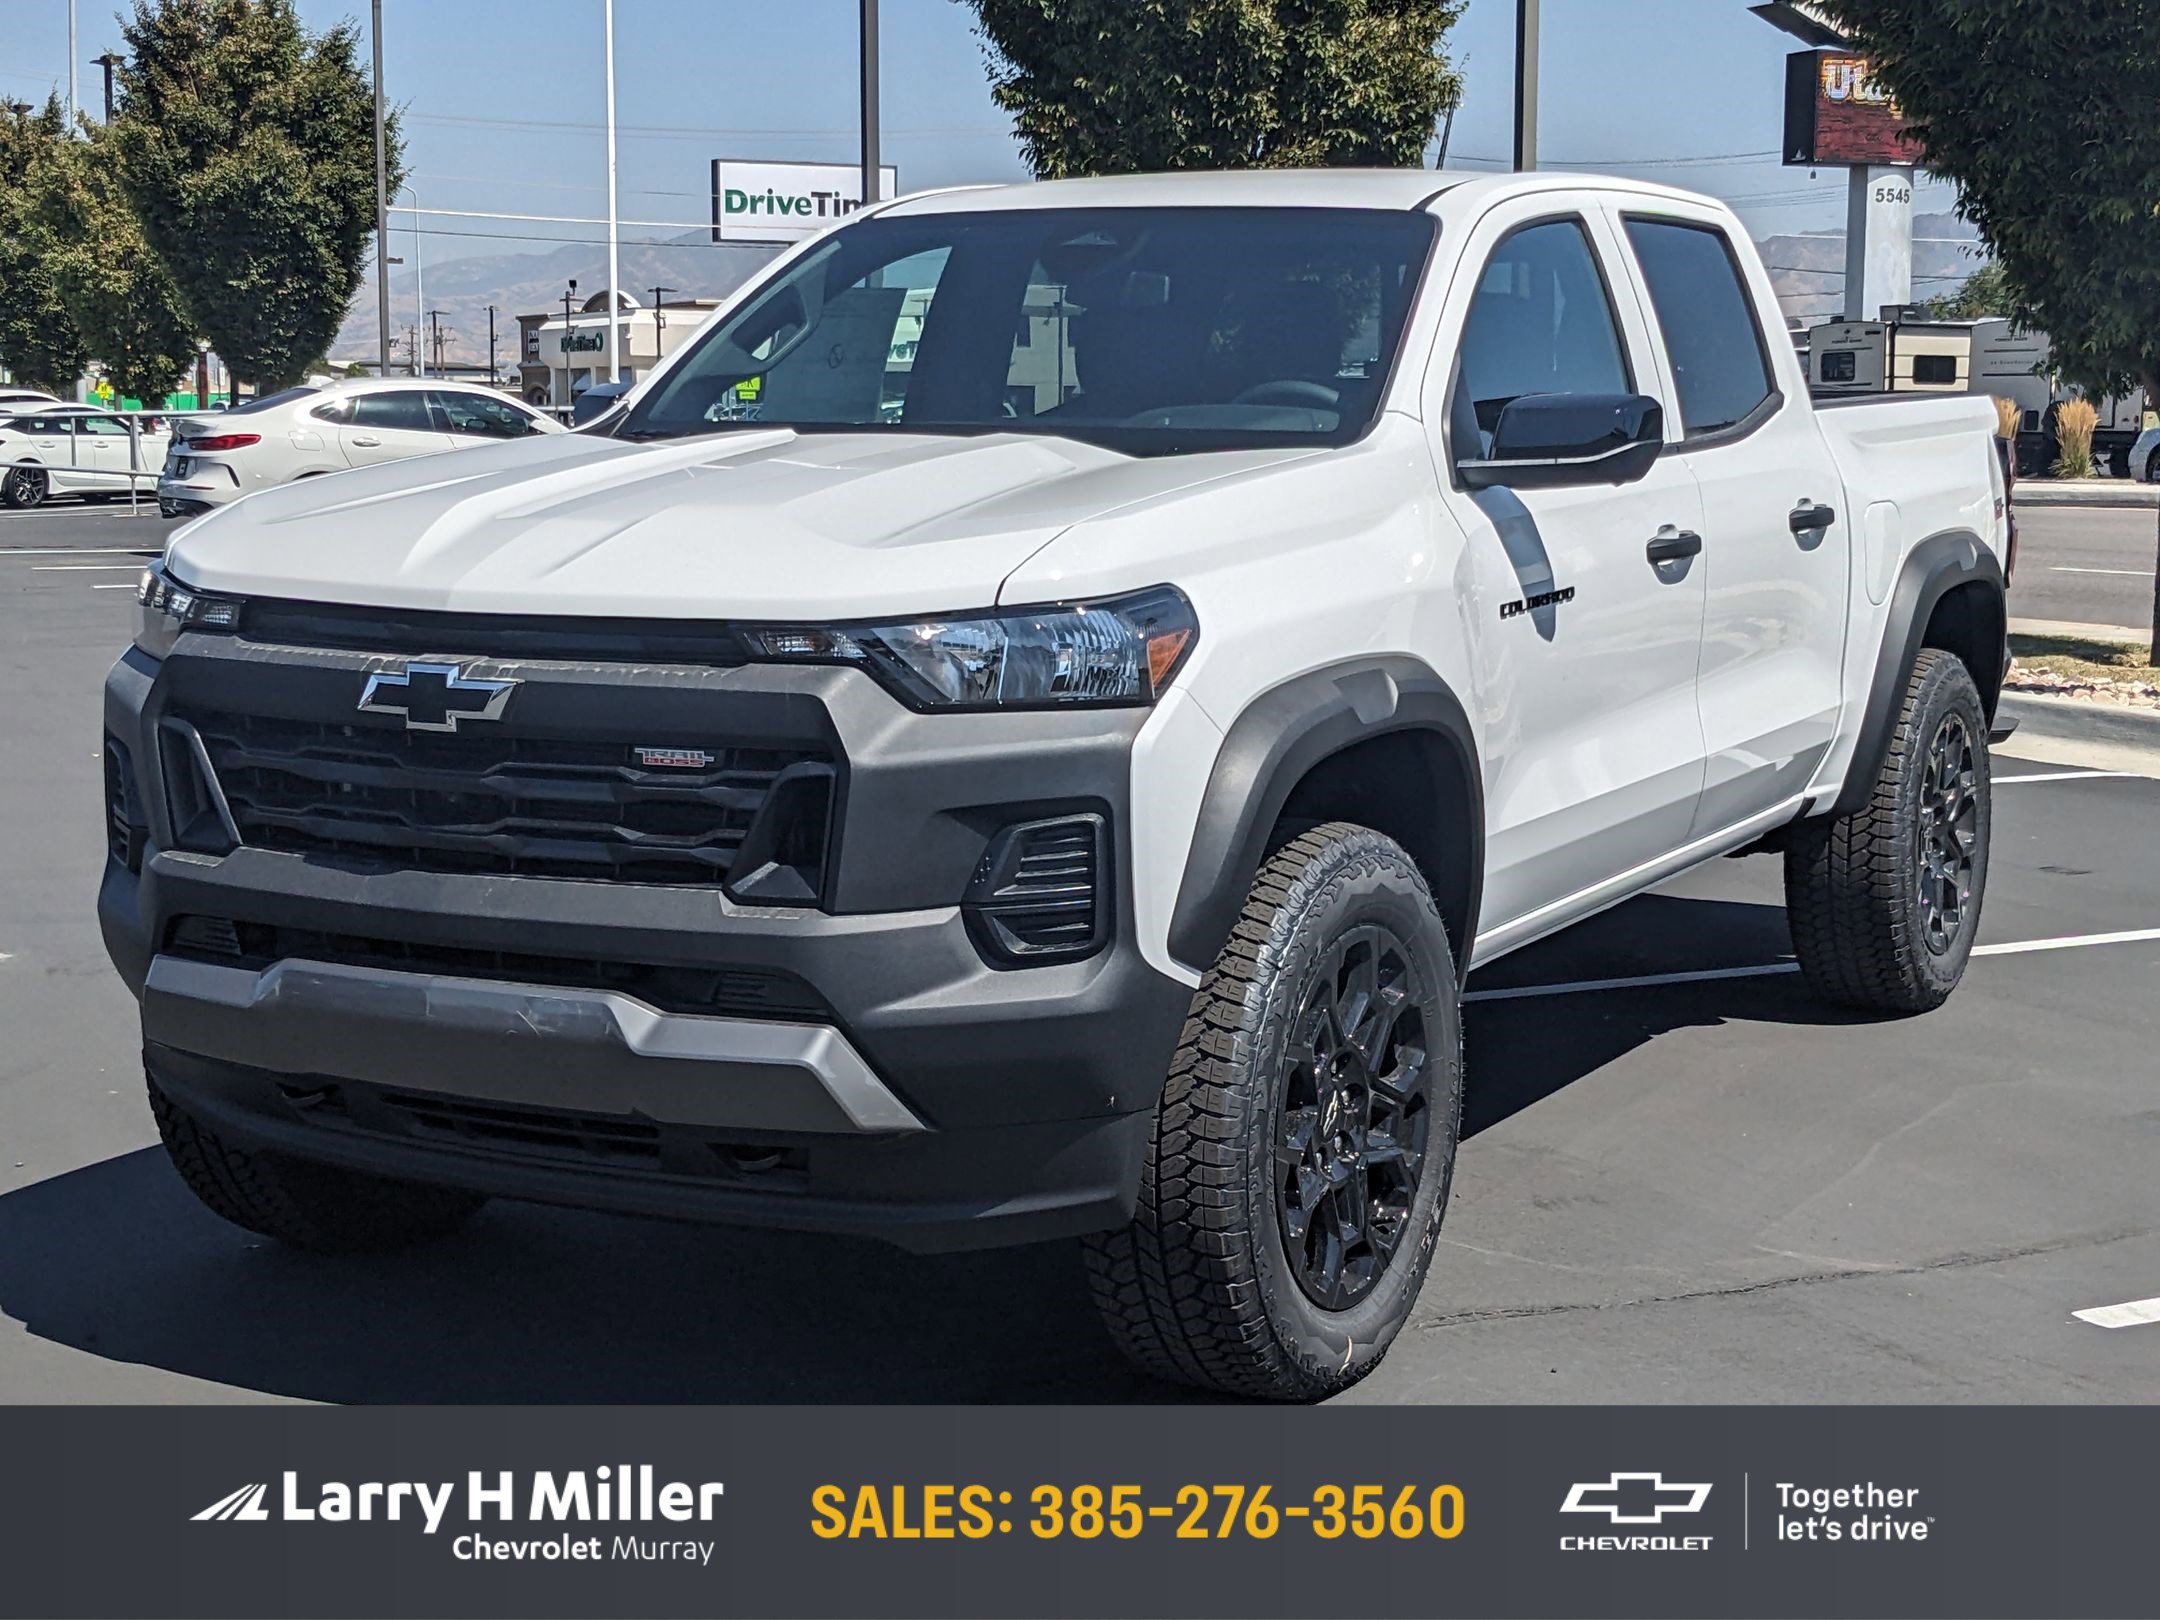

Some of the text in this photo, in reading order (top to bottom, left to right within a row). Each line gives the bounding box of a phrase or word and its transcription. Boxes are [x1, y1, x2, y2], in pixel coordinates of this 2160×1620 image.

[724, 188, 863, 217] DriveTi
[1875, 188, 1910, 204] 5545
[1500, 586, 1575, 620] COLORADO
